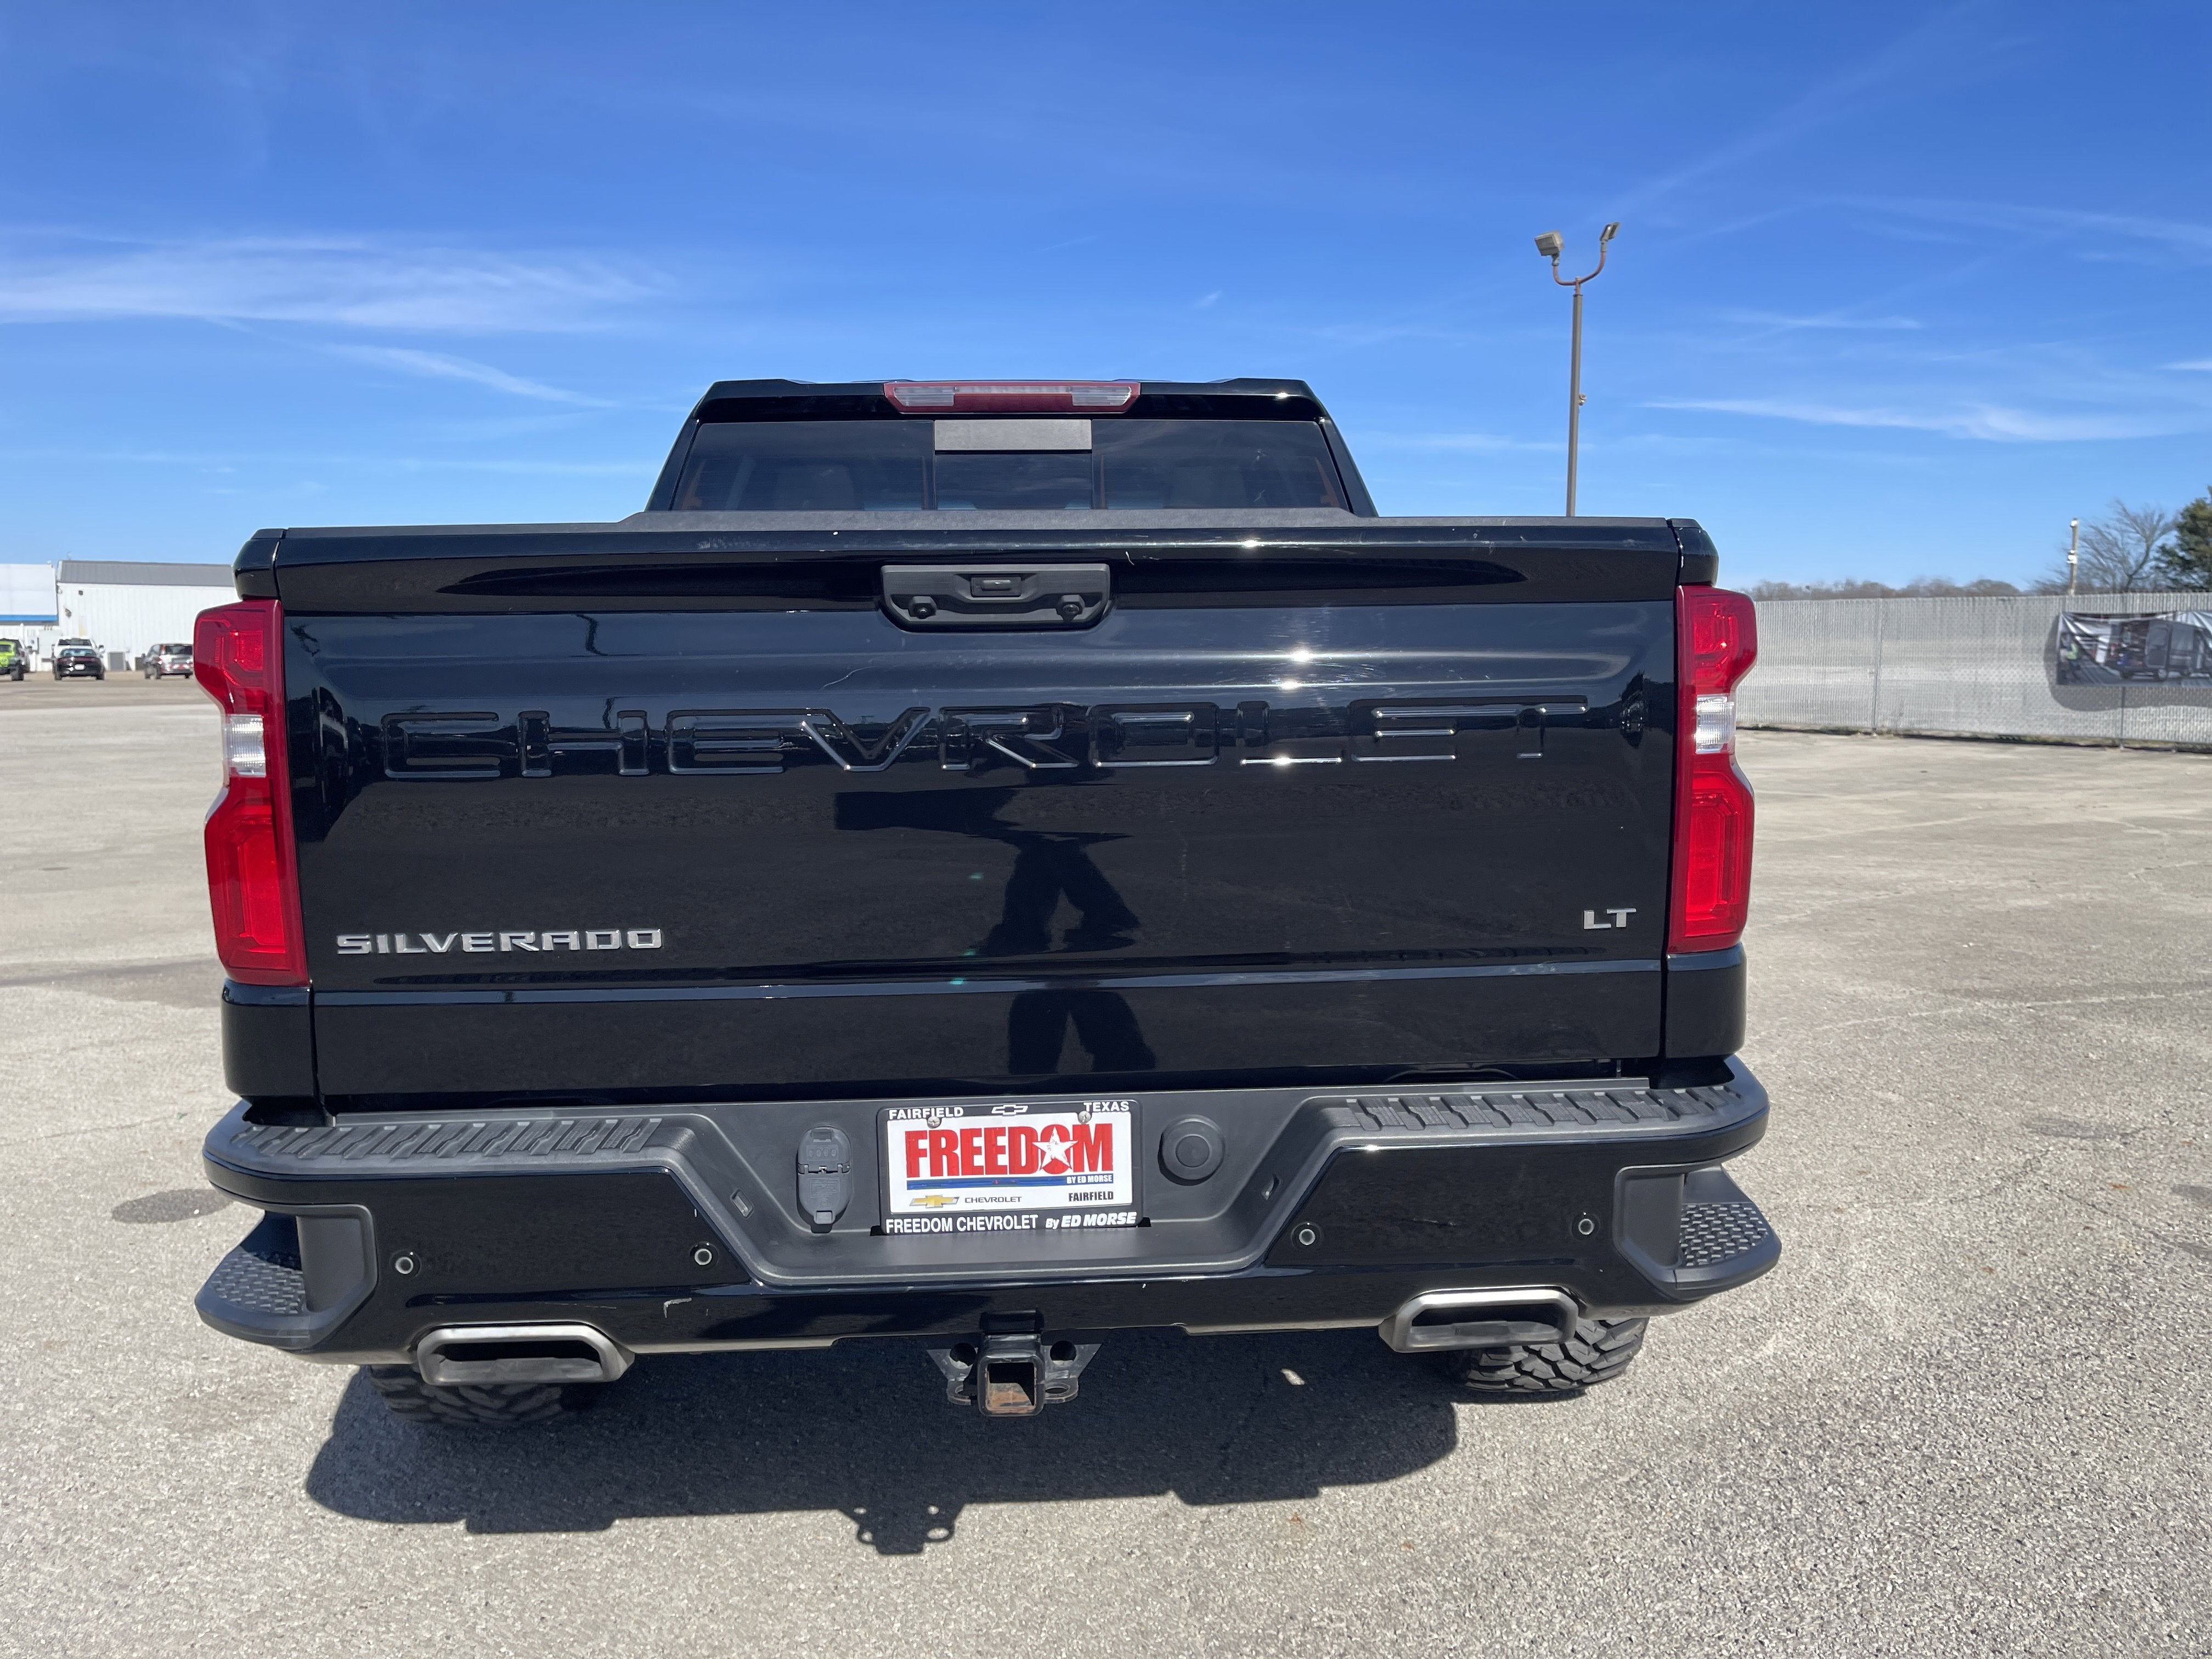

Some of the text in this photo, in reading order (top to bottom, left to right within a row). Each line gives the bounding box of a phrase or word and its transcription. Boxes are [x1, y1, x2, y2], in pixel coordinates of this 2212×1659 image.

[381, 695, 1587, 778] CHEVROLET
[1584, 908, 1637, 929] LT
[337, 929, 662, 955] SILVERADO
[889, 1101, 1130, 1120] FAIRFIELD TEXAS
[905, 1123, 1114, 1178] FREEDOM
[1087, 1175, 1113, 1183] MORSE
[1068, 1191, 1114, 1201] FAIRFIELD
[885, 1211, 1137, 1233] FREEDOM CHEVROLET By ED MORSE
